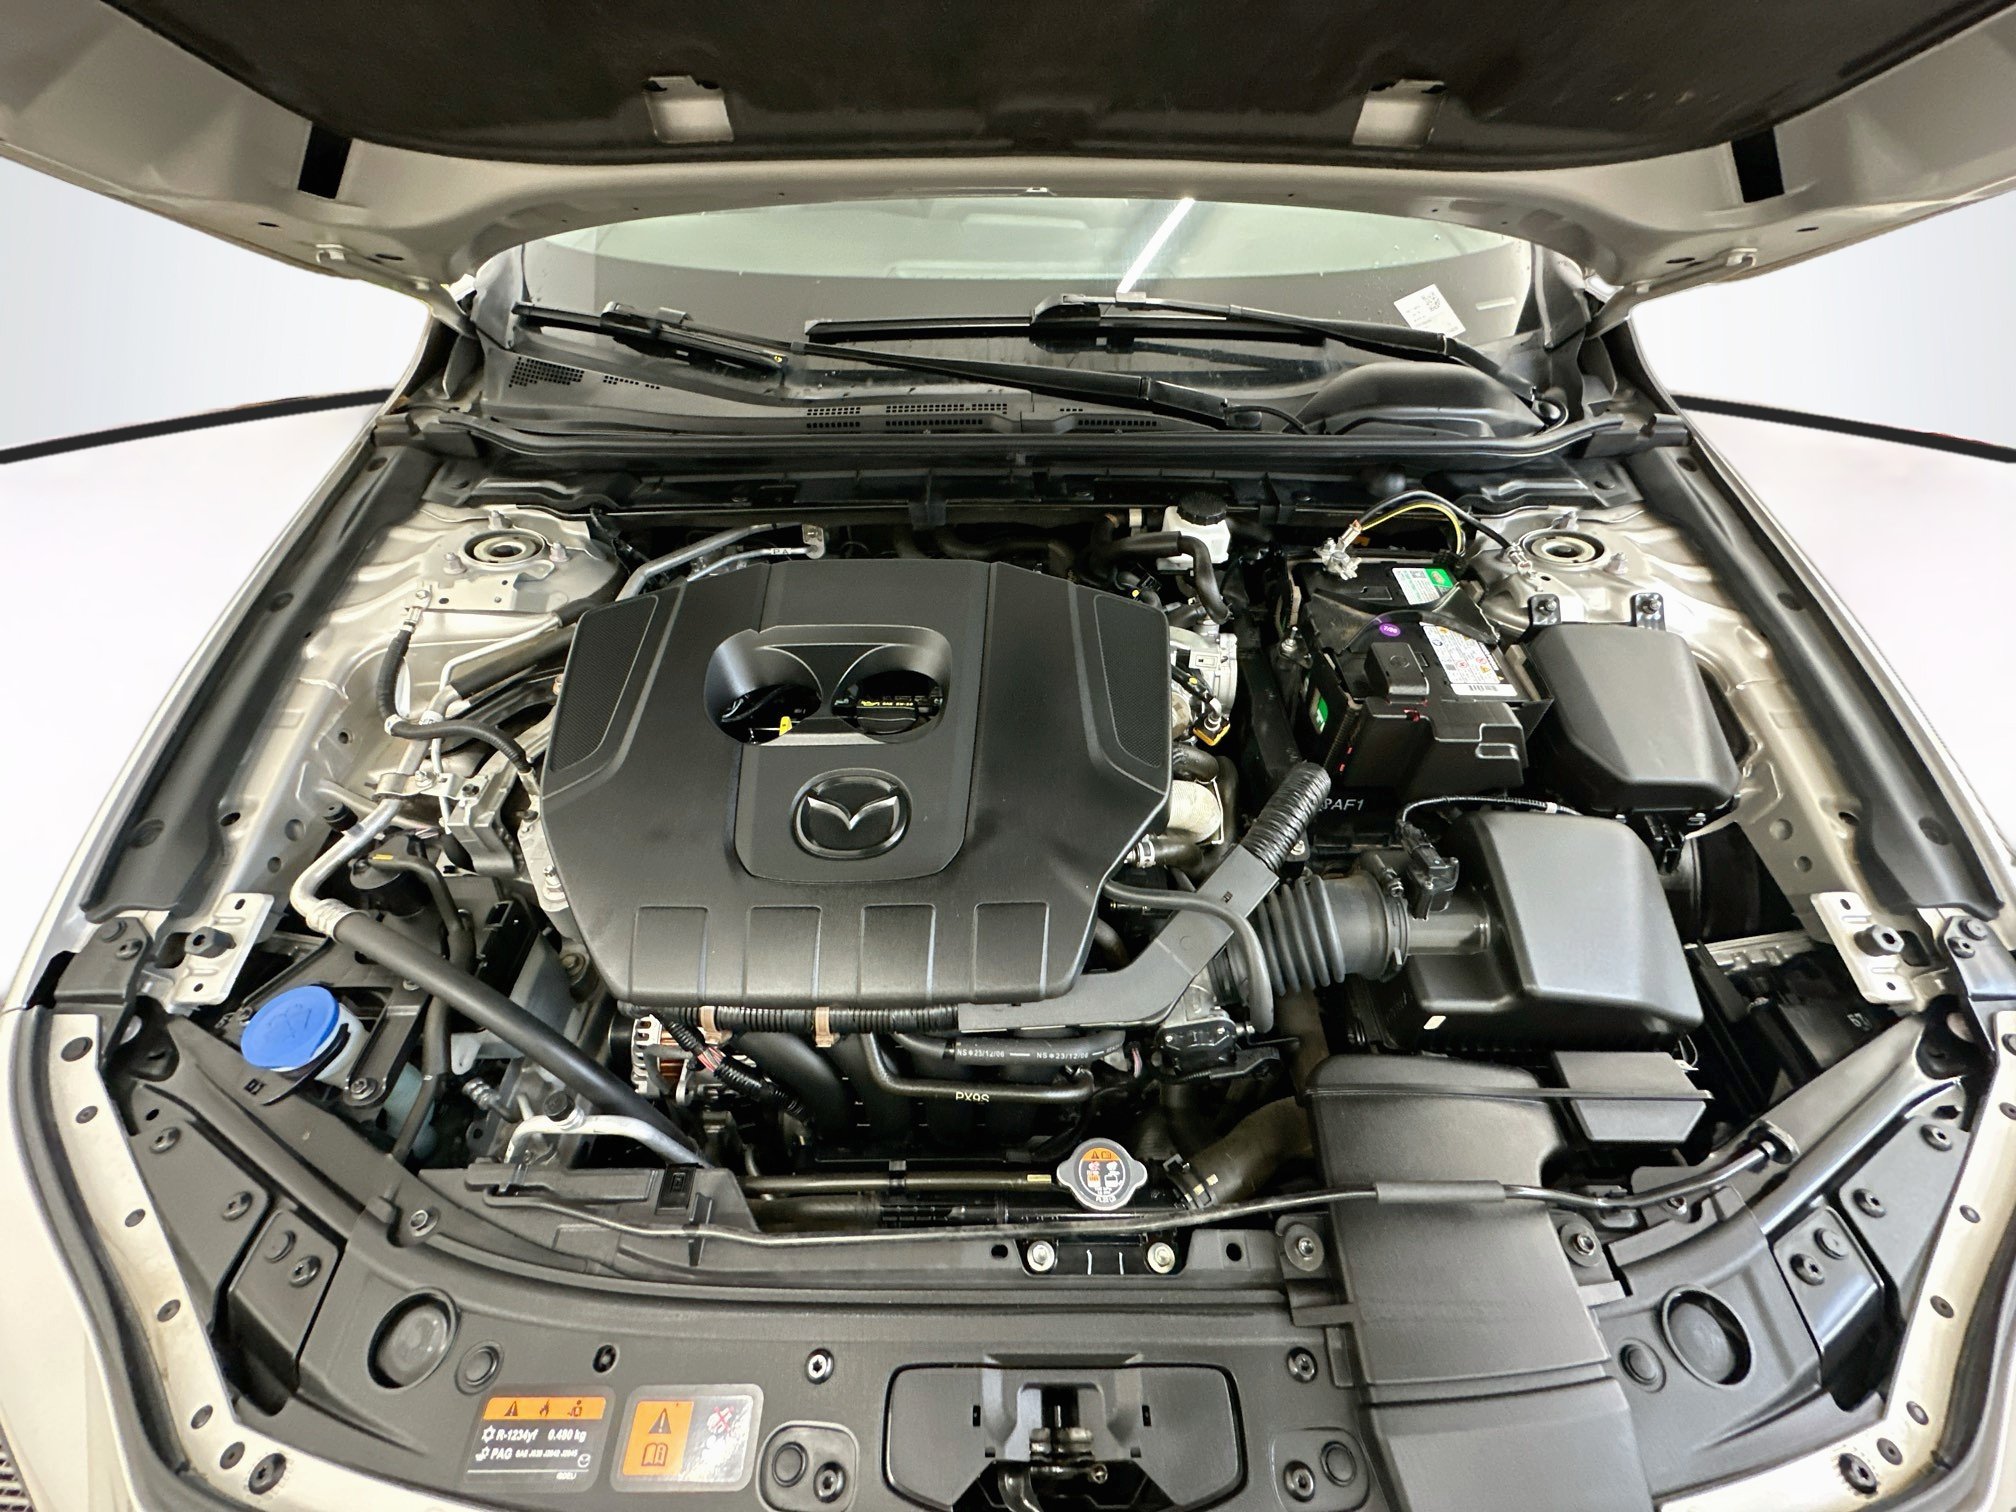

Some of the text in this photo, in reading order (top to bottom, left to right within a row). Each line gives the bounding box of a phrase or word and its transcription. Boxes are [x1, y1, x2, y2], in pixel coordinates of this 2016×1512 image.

[496, 1429, 539, 1443] R-1234yf
[574, 1428, 587, 1443] kg
[490, 1447, 513, 1460] PAG
